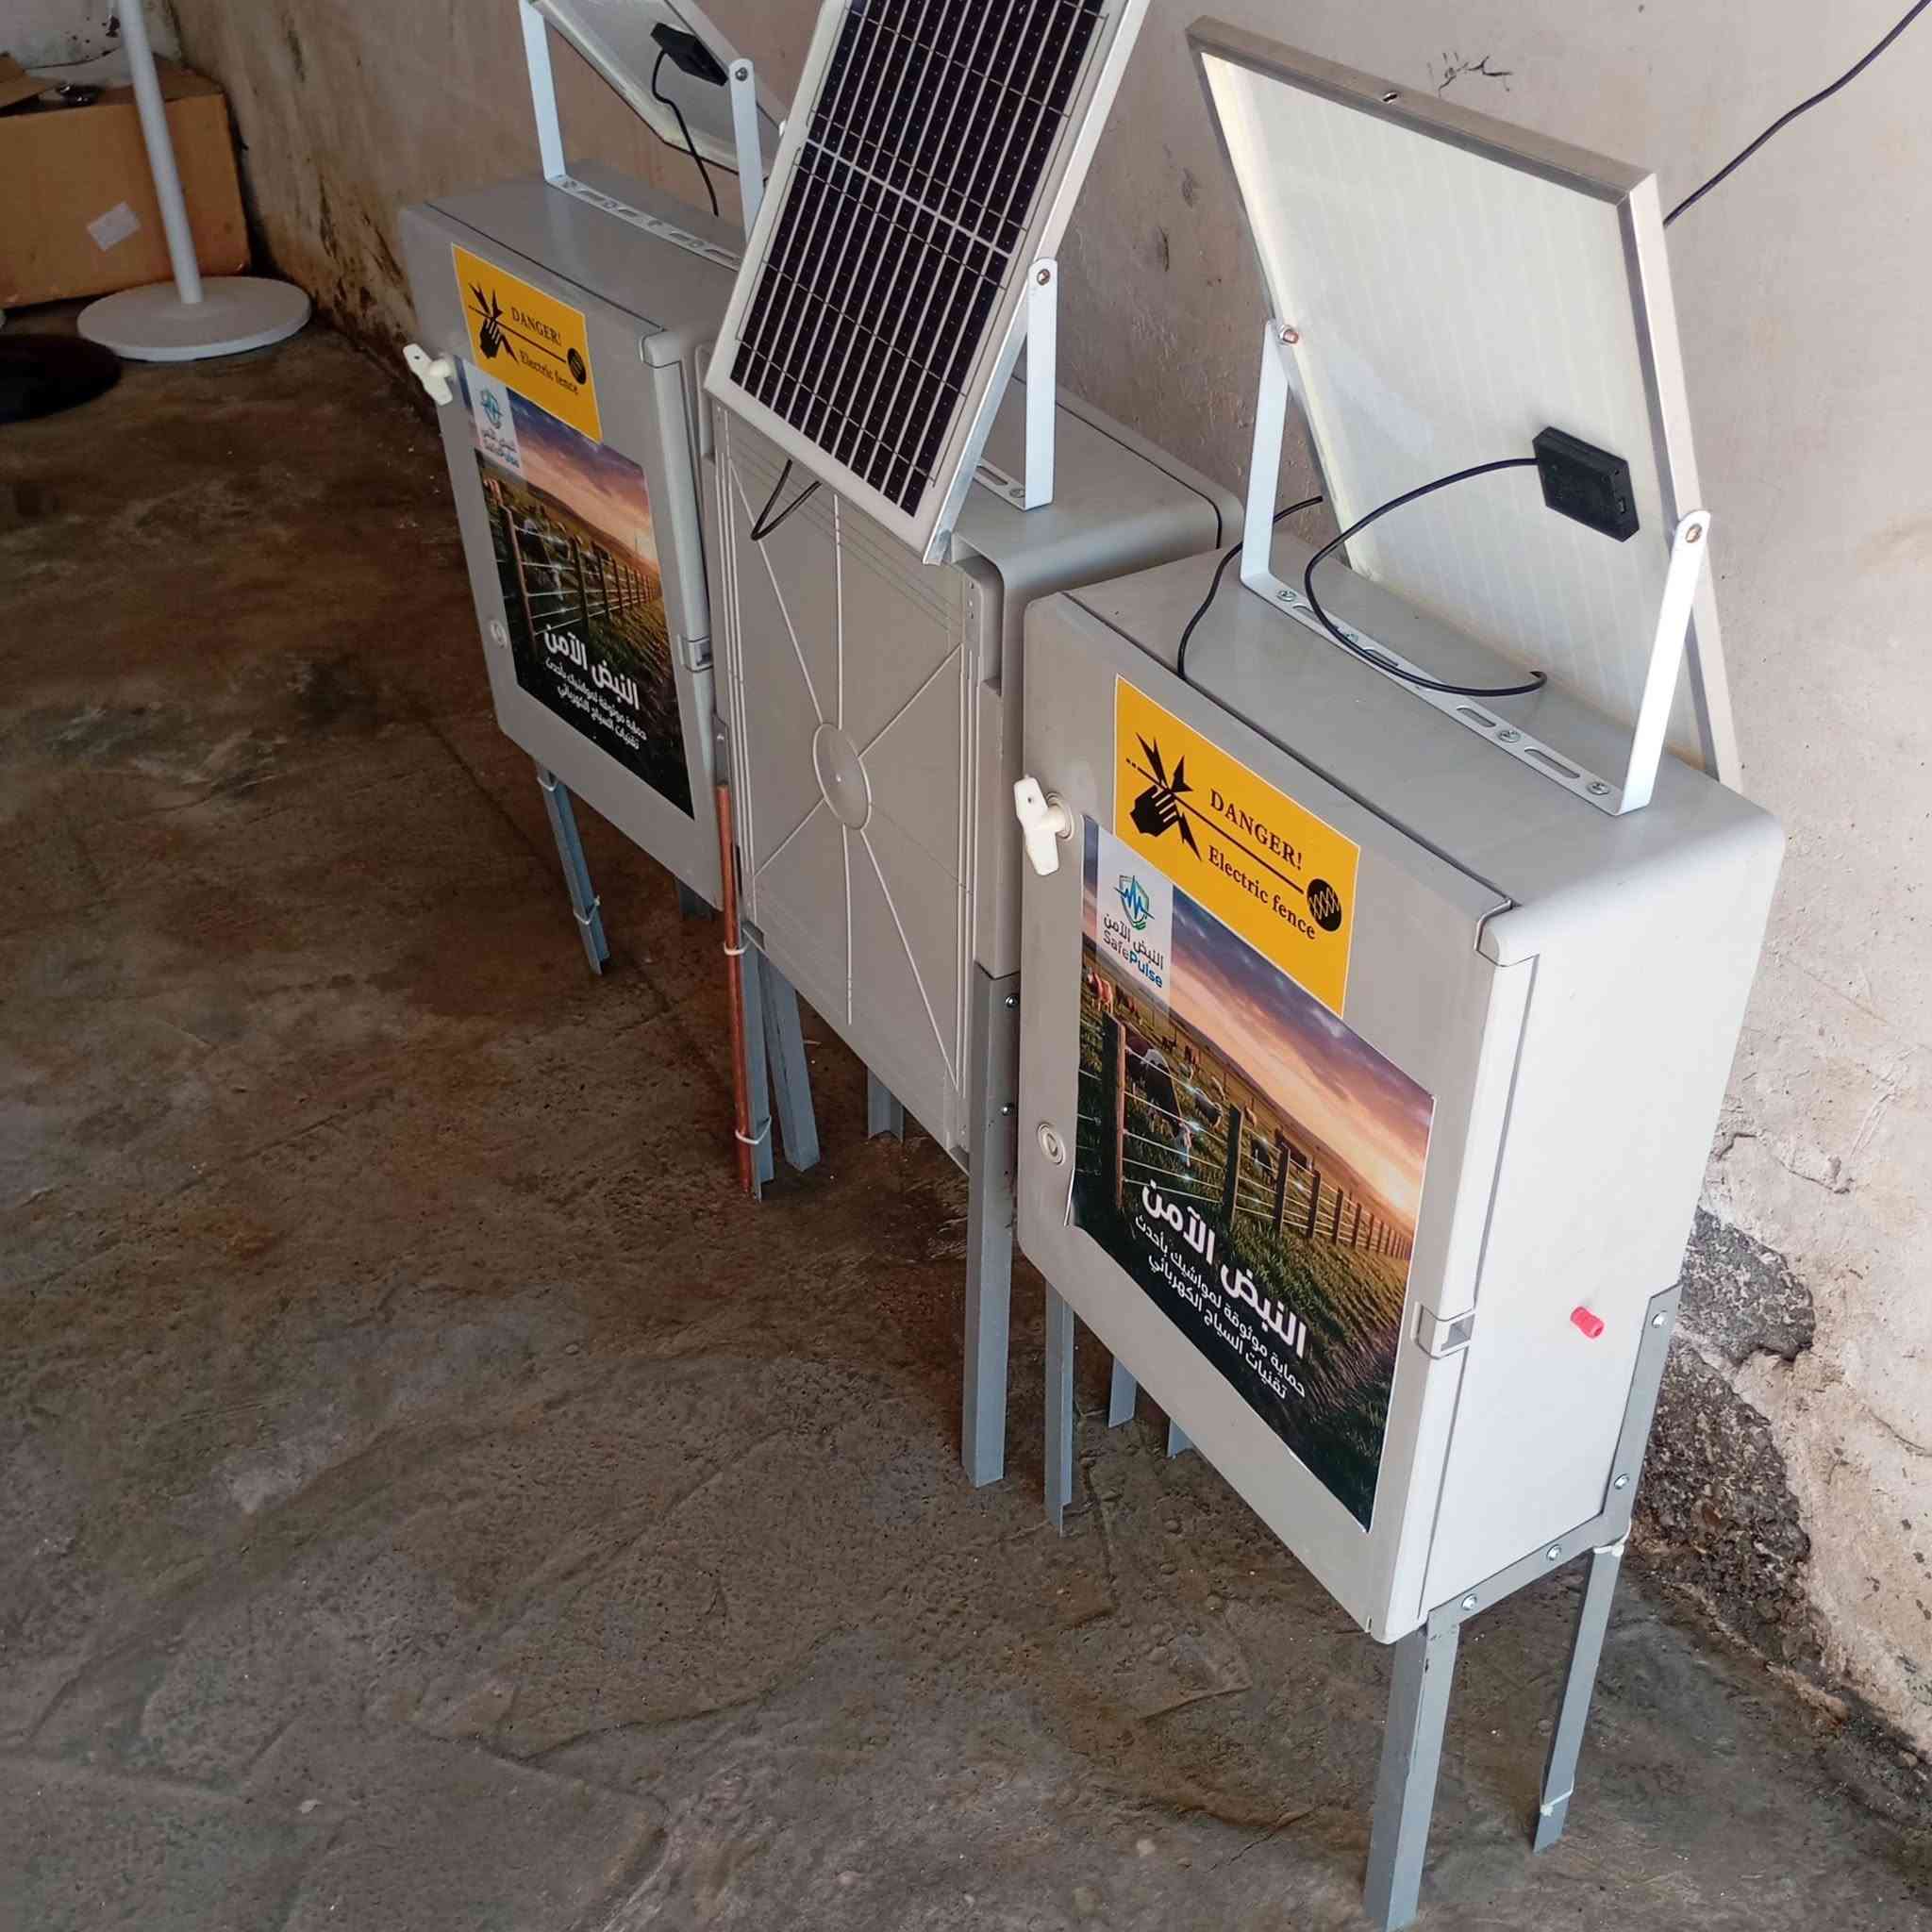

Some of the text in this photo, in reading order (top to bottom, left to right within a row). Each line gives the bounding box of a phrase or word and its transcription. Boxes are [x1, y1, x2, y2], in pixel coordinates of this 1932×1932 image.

[510, 307, 562, 346] DANGER!
[544, 624, 640, 710] النبض الآمن
[1209, 789, 1303, 871] DANGER!
[1208, 845, 1316, 940] Electric fence
[1103, 914, 1164, 970] النبض الآمن
[1103, 929, 1163, 989] SafePulse
[1141, 1179, 1307, 1358] النبض الآمن
[1170, 1252, 1222, 1308] لمواشيك
[1148, 1255, 1287, 1399] تقنيات السياج الكهربائي
[1224, 1303, 1268, 1357] موثوقة
[1271, 1352, 1306, 1398] حماية
